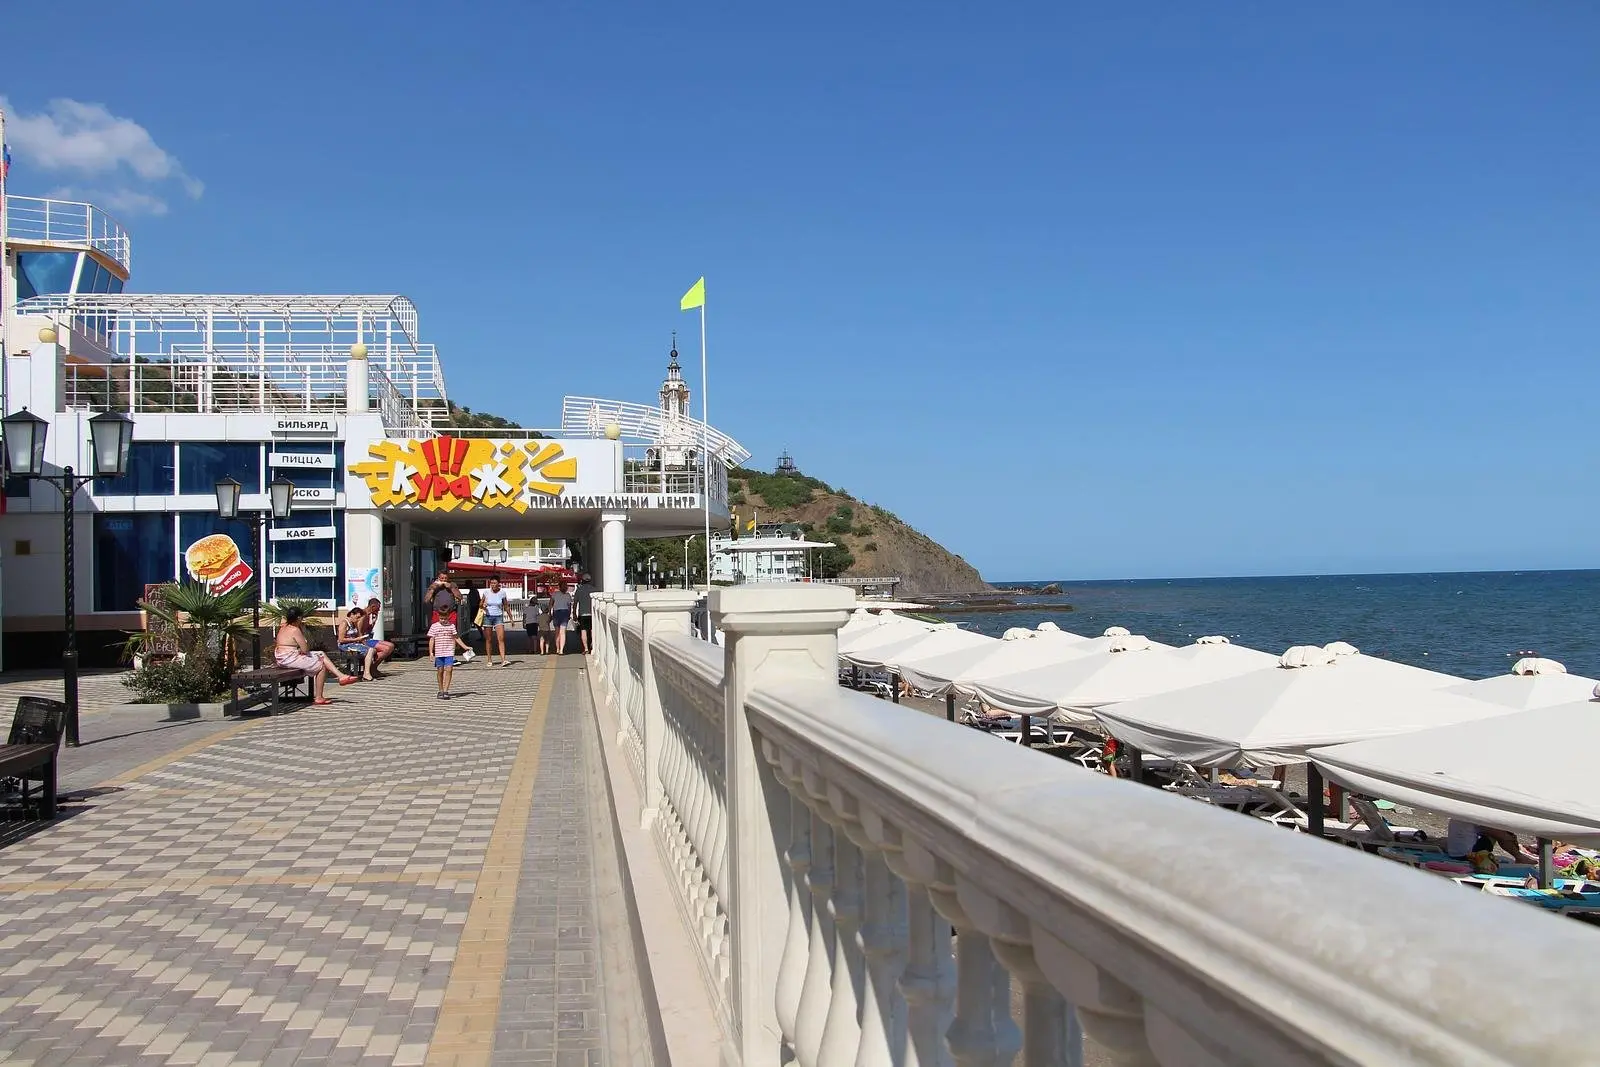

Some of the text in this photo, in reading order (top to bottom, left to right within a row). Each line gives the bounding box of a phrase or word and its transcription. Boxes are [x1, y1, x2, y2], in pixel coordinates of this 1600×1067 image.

[277, 421, 328, 430] БИЛЬЯРД
[282, 455, 322, 464] ПИЦЦА
[291, 489, 320, 497] ИСКО
[530, 495, 696, 509] ПРИВЛЕКАТЕЛЬНЫЙ ЦЕНТР
[286, 529, 316, 538] КАФЕ
[272, 566, 334, 575] СУШИ-КУХНЯ
